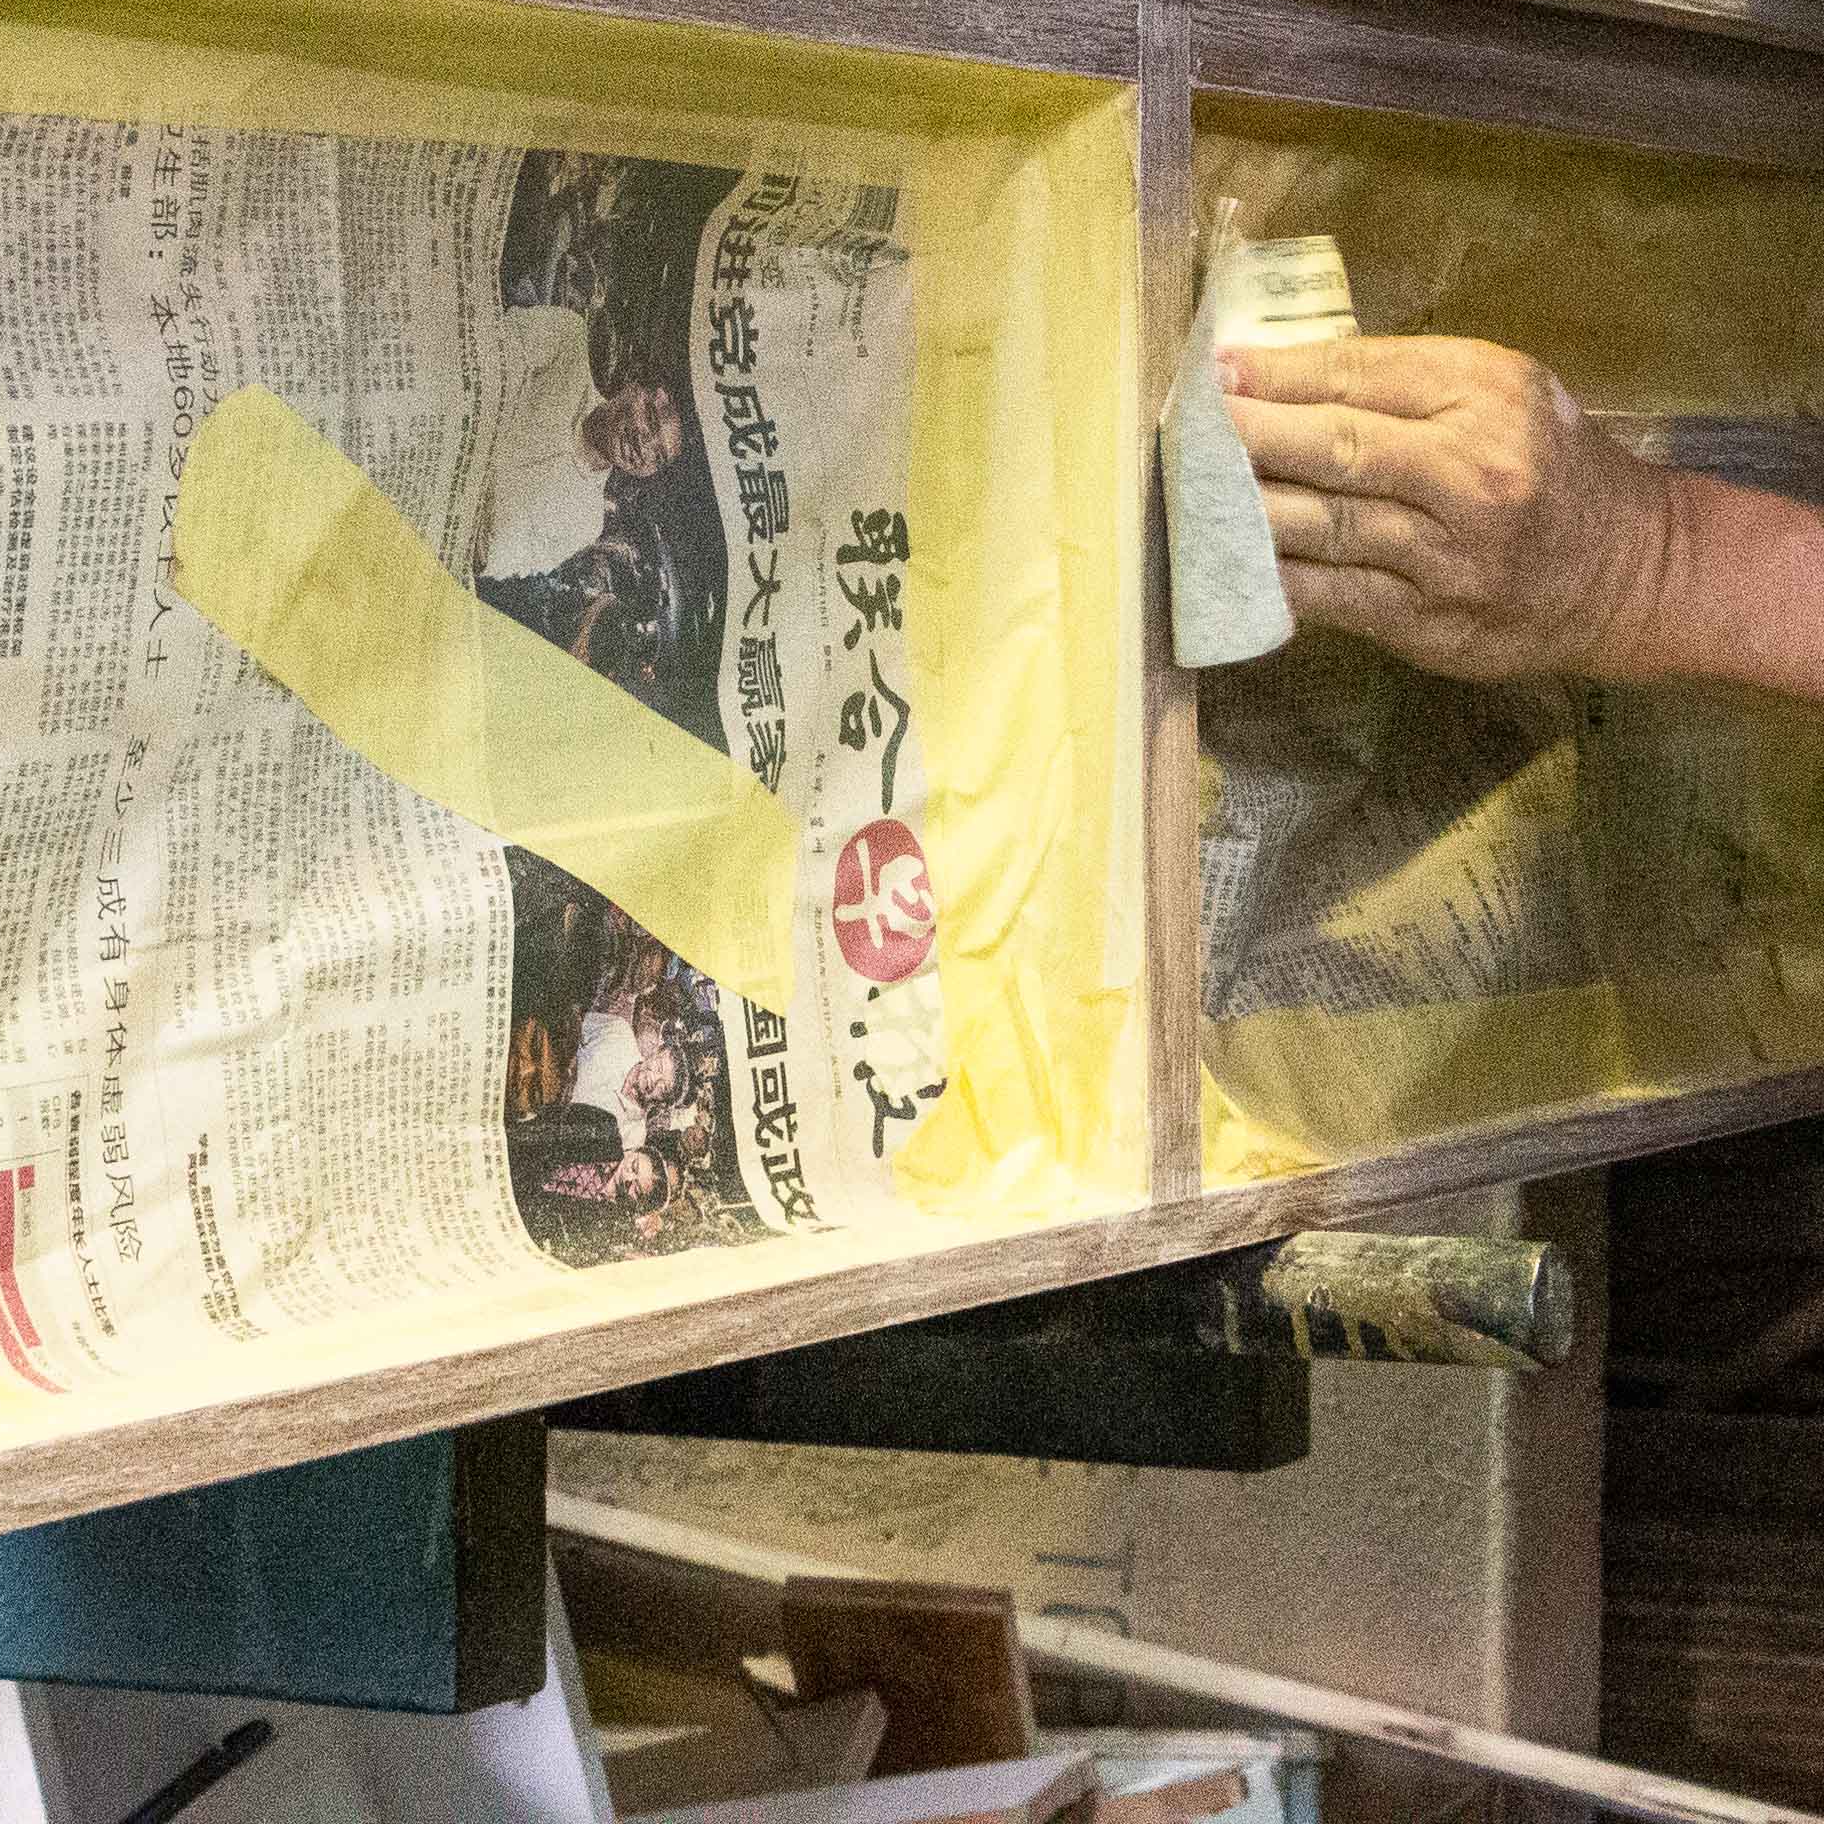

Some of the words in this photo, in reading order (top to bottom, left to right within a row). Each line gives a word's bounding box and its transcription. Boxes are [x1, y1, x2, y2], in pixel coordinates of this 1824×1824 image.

[178, 125, 219, 416] 括肌肉流失行动力
[96, 733, 151, 1263] 至少三成有身体虚弱风险
[741, 998, 844, 1234] 国或政
